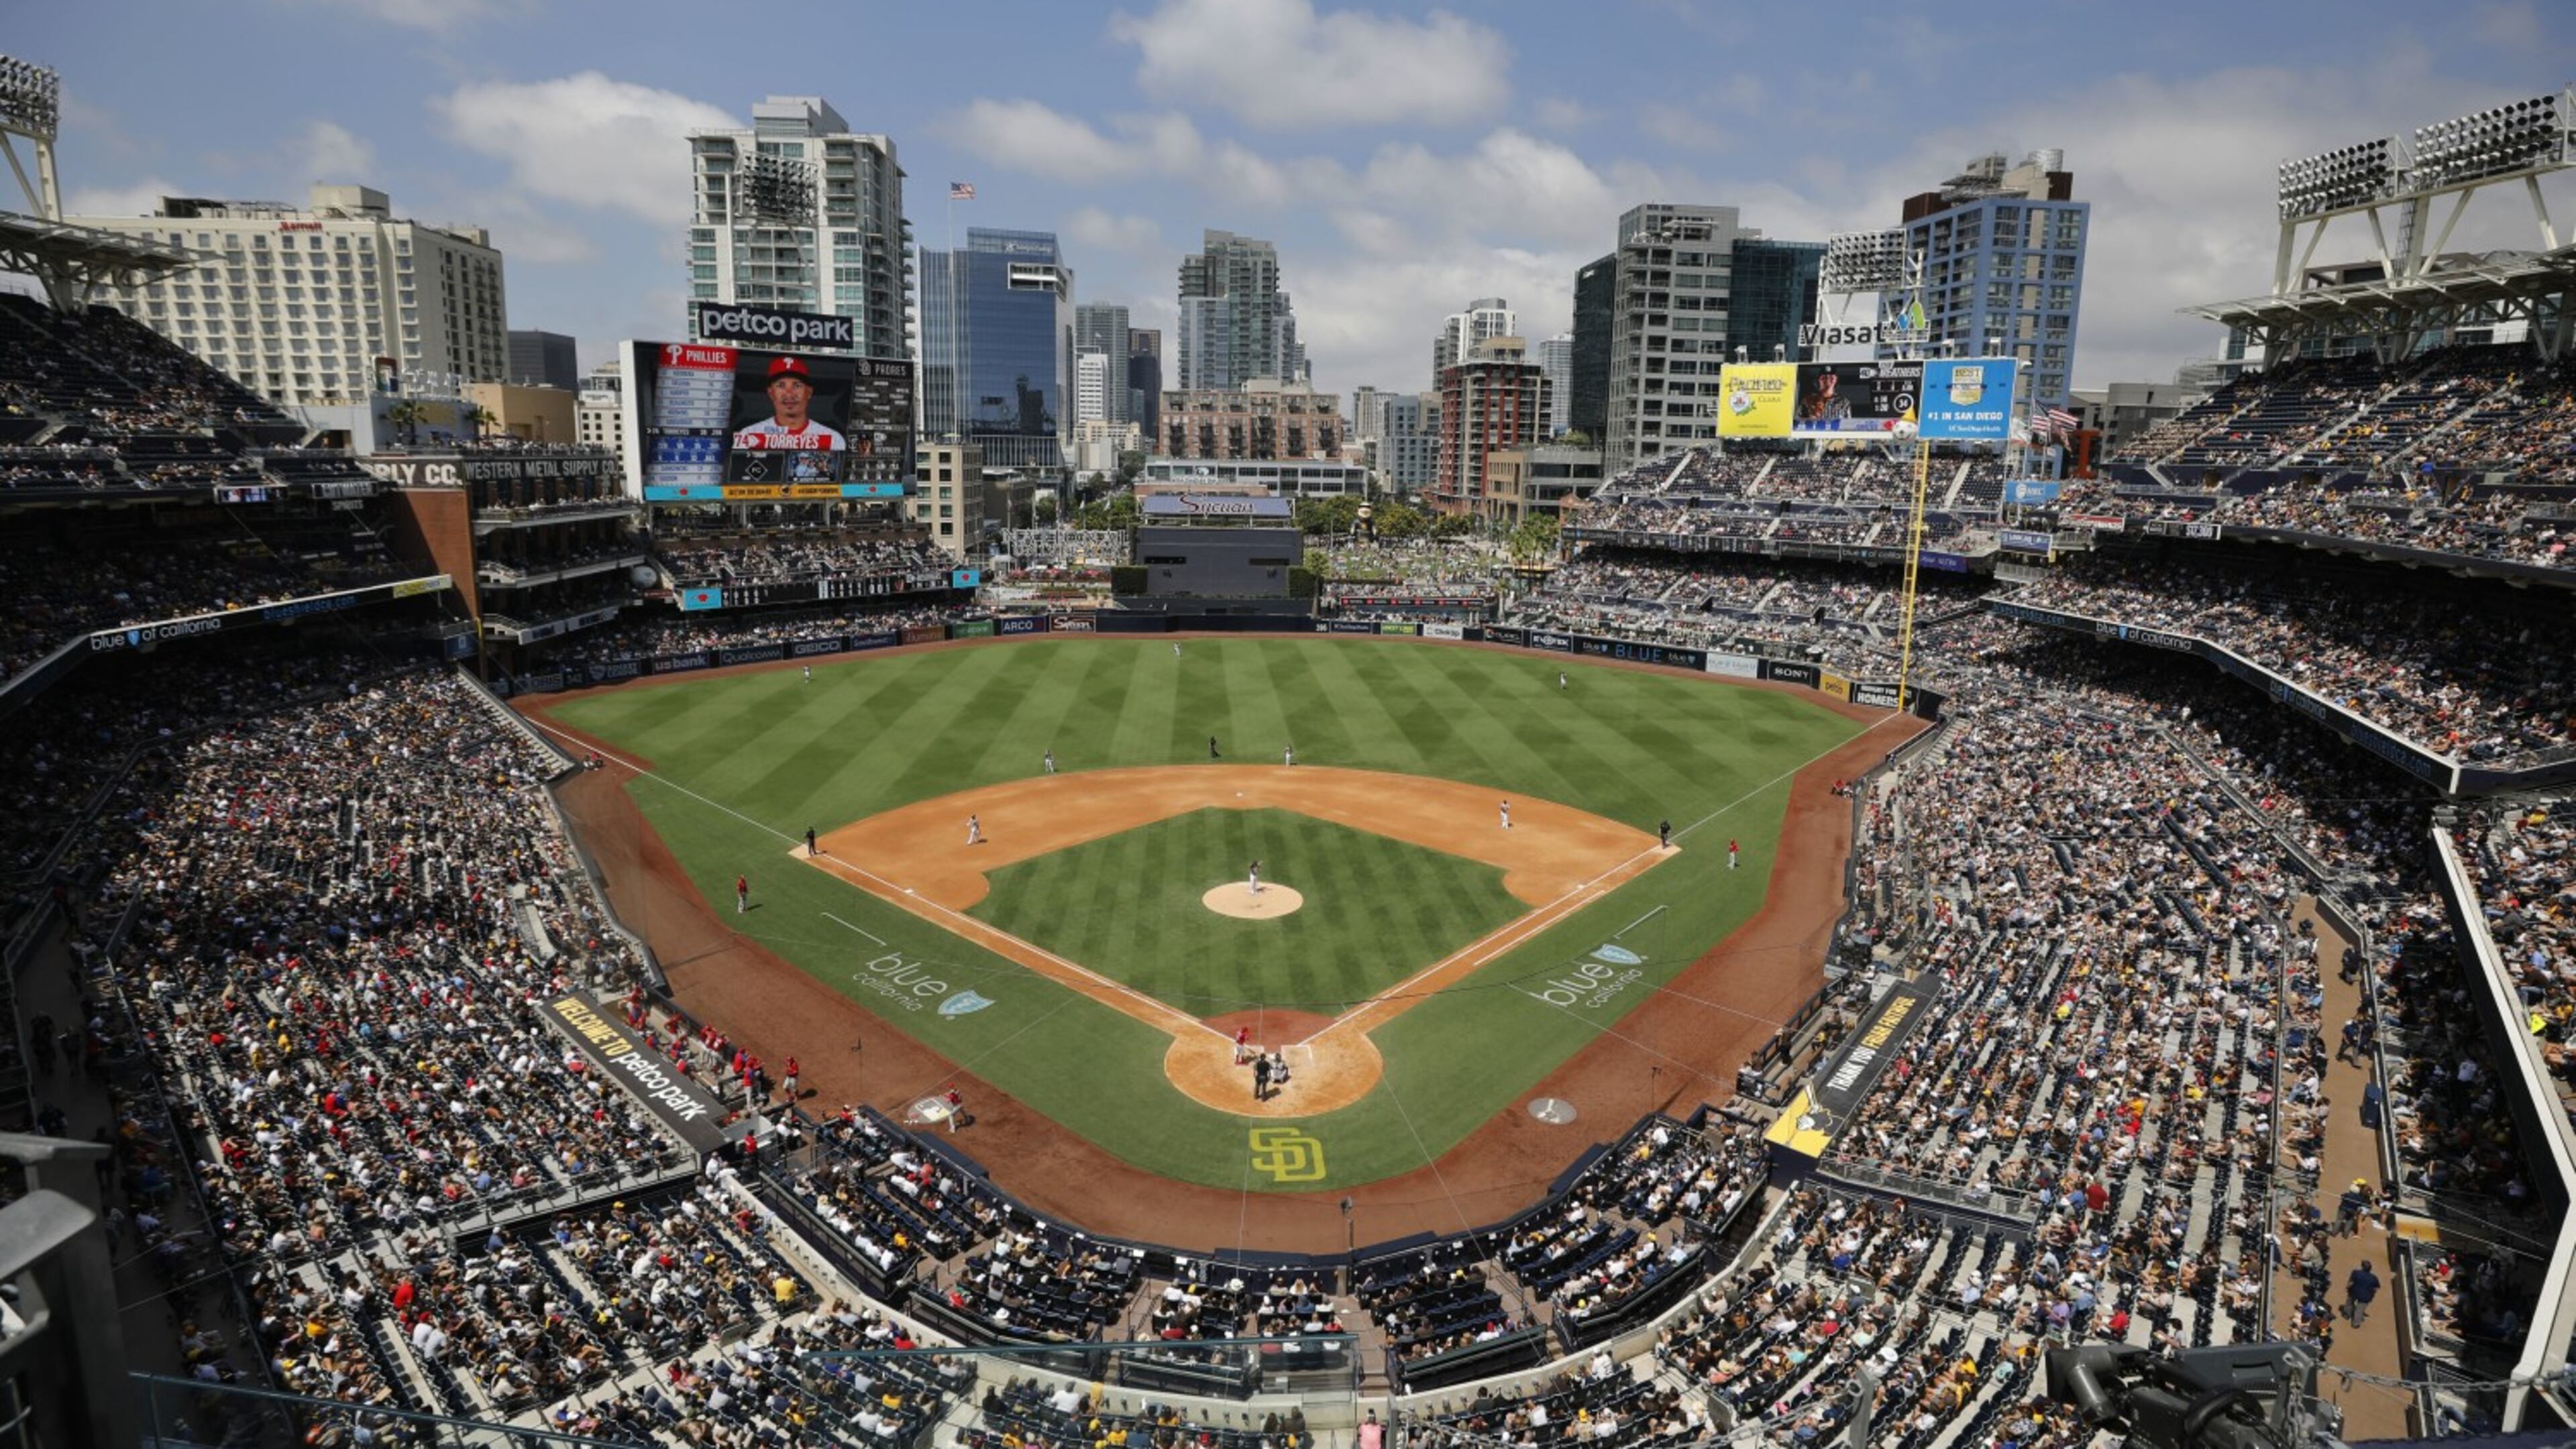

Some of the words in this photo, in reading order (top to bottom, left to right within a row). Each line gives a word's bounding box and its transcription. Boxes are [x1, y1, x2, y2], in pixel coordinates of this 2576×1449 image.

[702, 307, 787, 336] petco
[791, 319, 851, 343] park
[1803, 322, 1886, 344] Viasat
[686, 350, 727, 363] PHILLIES
[875, 364, 906, 376] PADRES
[1955, 369, 1979, 377] BEST
[1928, 412, 1938, 421] #1
[1942, 413, 1951, 421] IN
[1954, 413, 1974, 421] SAN
[1976, 412, 2003, 421] DIEGO
[764, 435, 820, 449] TORREYES
[425, 464, 463, 485] CO.
[465, 462, 521, 480] WESTERN
[525, 460, 560, 478] METAL
[563, 460, 598, 476] SUPPLY
[91, 635, 125, 650] blue
[142, 629, 157, 641] of
[160, 618, 221, 638] california
[1004, 620, 1033, 631] ARCO
[1583, 642, 1599, 650] blue
[2096, 622, 2117, 636] blue
[2129, 629, 2139, 639] of
[2141, 631, 2192, 650] california
[722, 650, 780, 663] Qualcomm
[795, 640, 840, 654] GEICO
[1615, 644, 1662, 663] BLUE
[1668, 653, 1686, 661] blue
[673, 655, 706, 668] bank
[1774, 667, 1809, 678] SONY
[1825, 681, 1843, 695] petco
[1858, 692, 1900, 707] HOMERS
[865, 952, 948, 996] blue
[853, 973, 923, 1011] california
[1529, 963, 1613, 1007] blue
[1587, 969, 1642, 1008] california
[552, 997, 618, 1044] WELCOME
[1877, 996, 1916, 1029] FAITHFUL
[1861, 1025, 1893, 1049] FRIAR
[600, 1038, 633, 1057] TO
[1847, 1045, 1876, 1065] YOU
[609, 1052, 670, 1089] petco
[1827, 1061, 1866, 1091] THANK
[649, 1086, 707, 1121] park
[1249, 1127, 1326, 1181] SD
